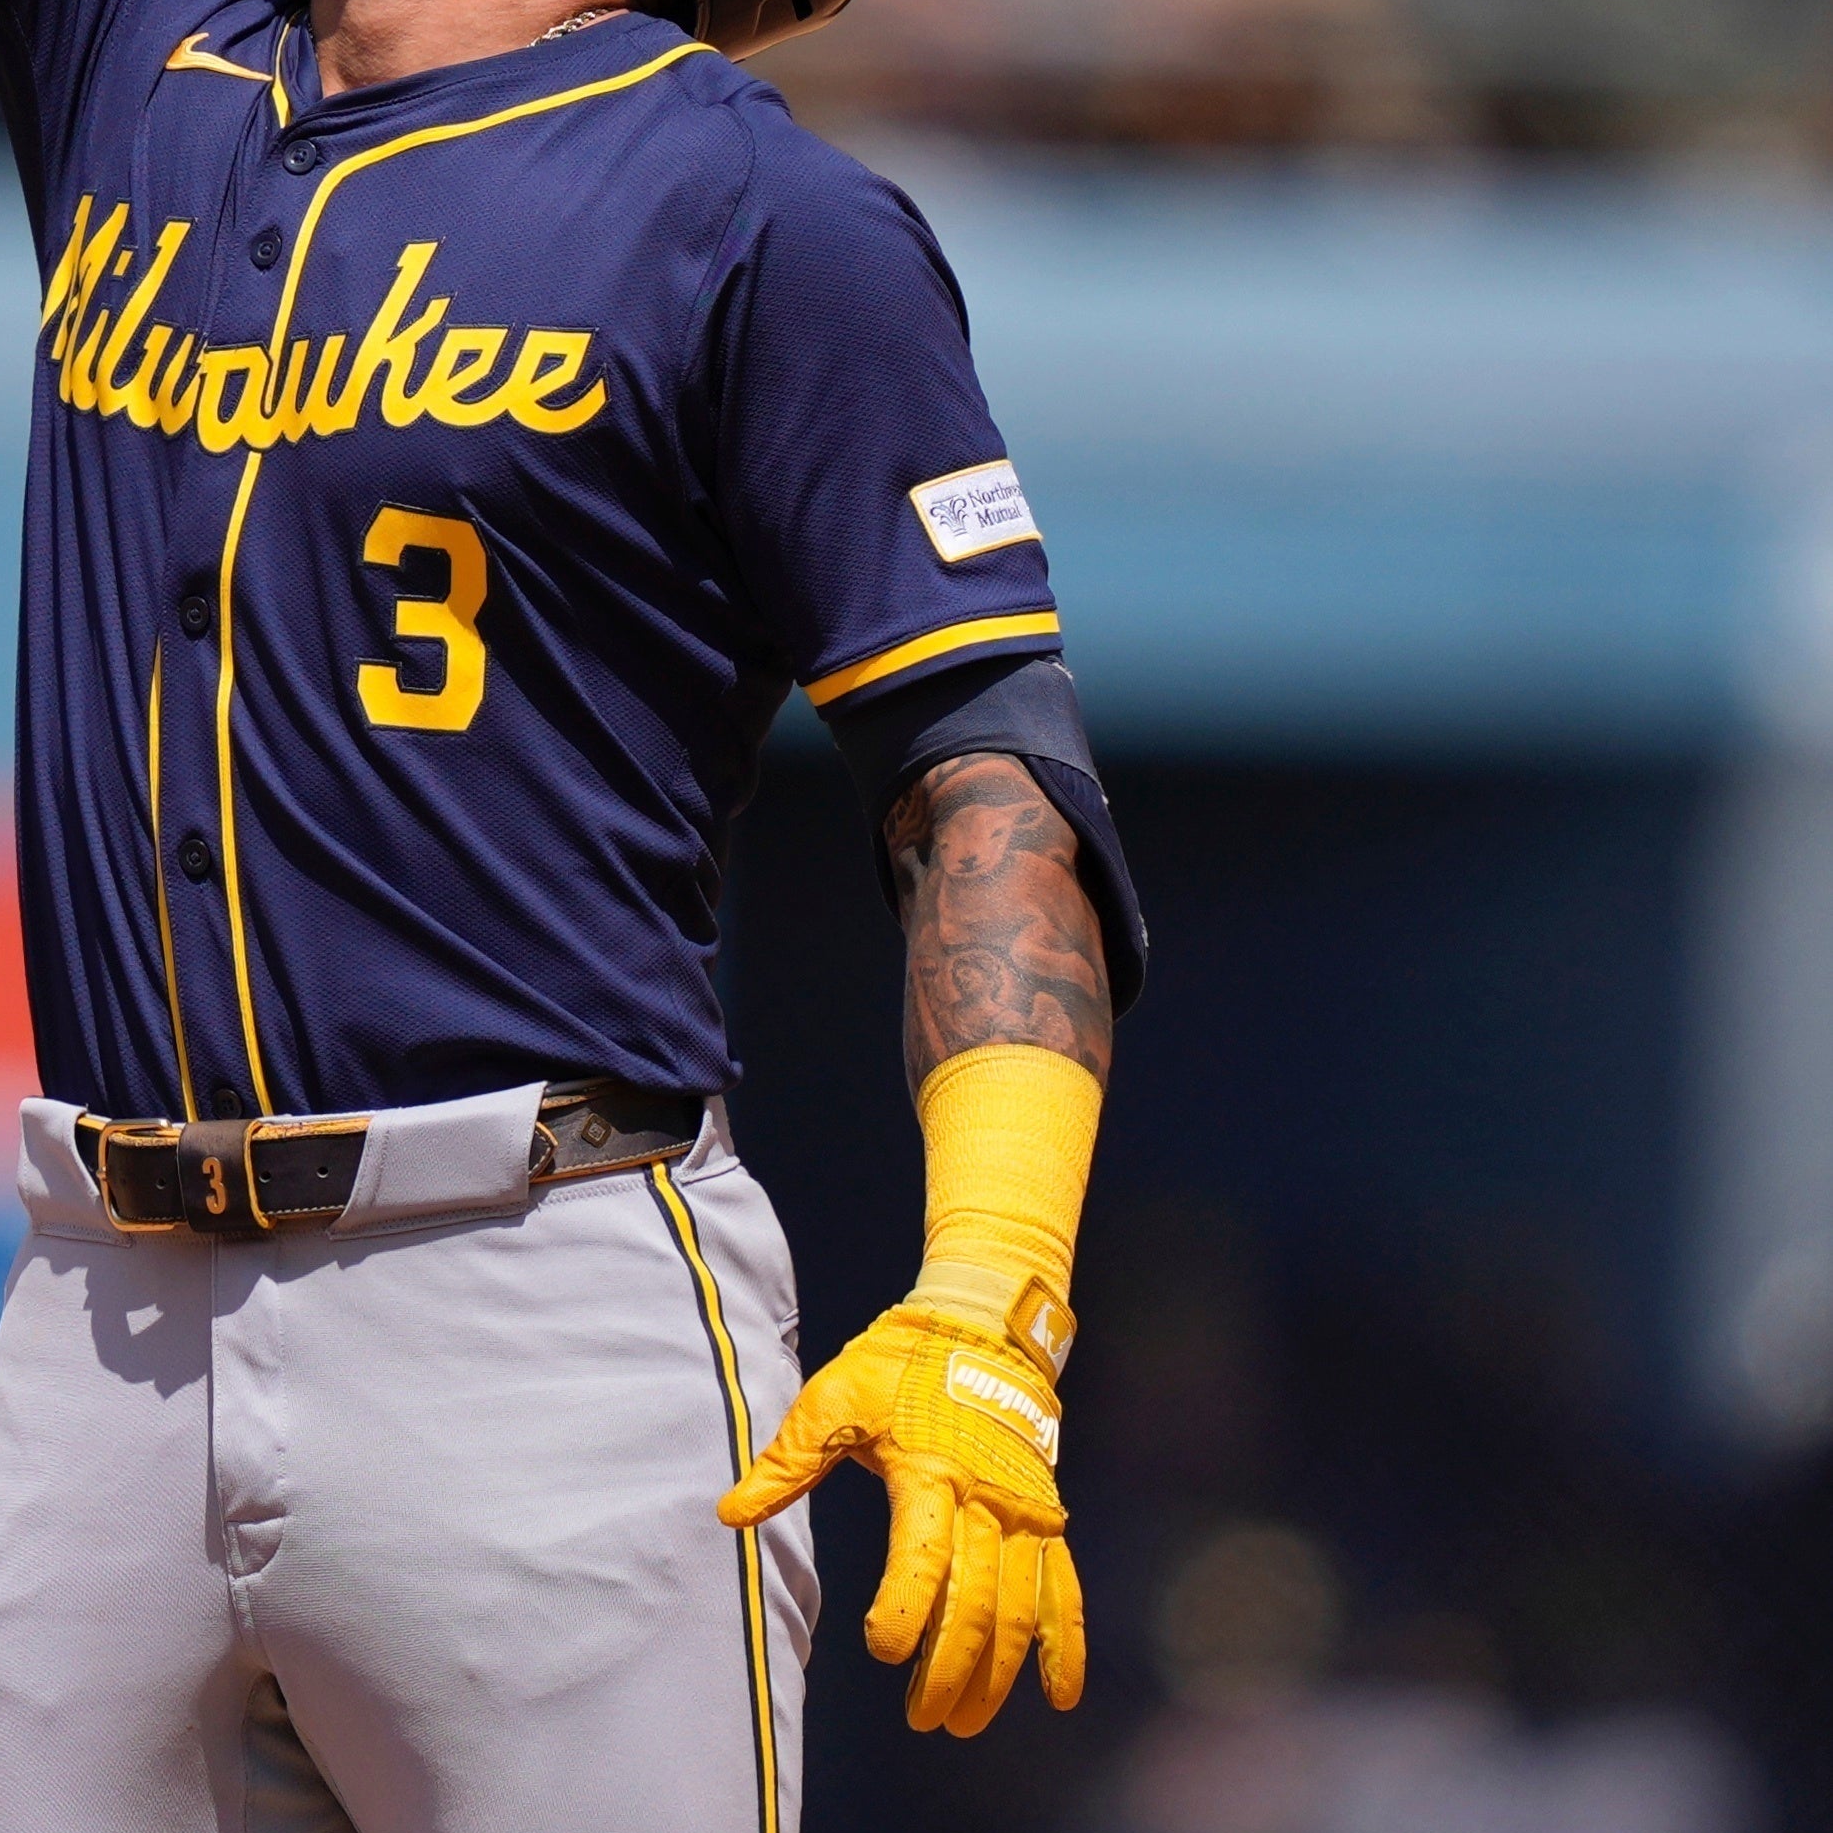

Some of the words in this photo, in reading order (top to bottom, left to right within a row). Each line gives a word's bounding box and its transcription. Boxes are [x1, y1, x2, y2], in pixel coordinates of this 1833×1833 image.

[39, 192, 610, 455] Milwaukee
[976, 501, 1023, 529] Mutual
[356, 500, 491, 733] 3
[201, 1155, 227, 1215] 3
